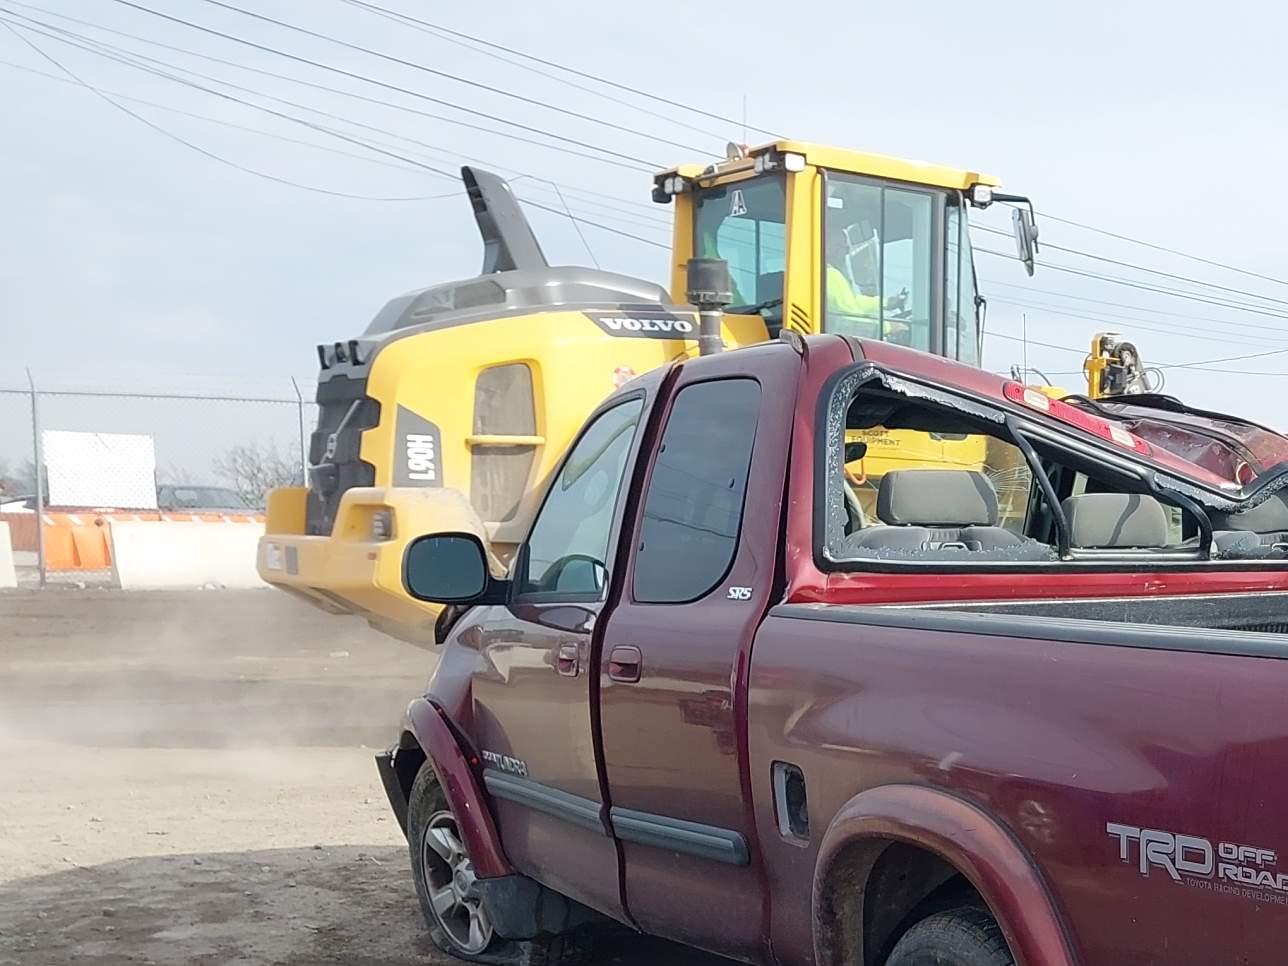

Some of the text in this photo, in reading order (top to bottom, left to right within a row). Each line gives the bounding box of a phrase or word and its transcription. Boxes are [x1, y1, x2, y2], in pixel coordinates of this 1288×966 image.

[599, 318, 693, 333] VOLVO
[405, 434, 436, 480] L90H
[727, 586, 753, 600] SR5
[1106, 822, 1214, 883] TRD
[1217, 842, 1278, 868] OFF
[1186, 877, 1212, 890] TOYOTA
